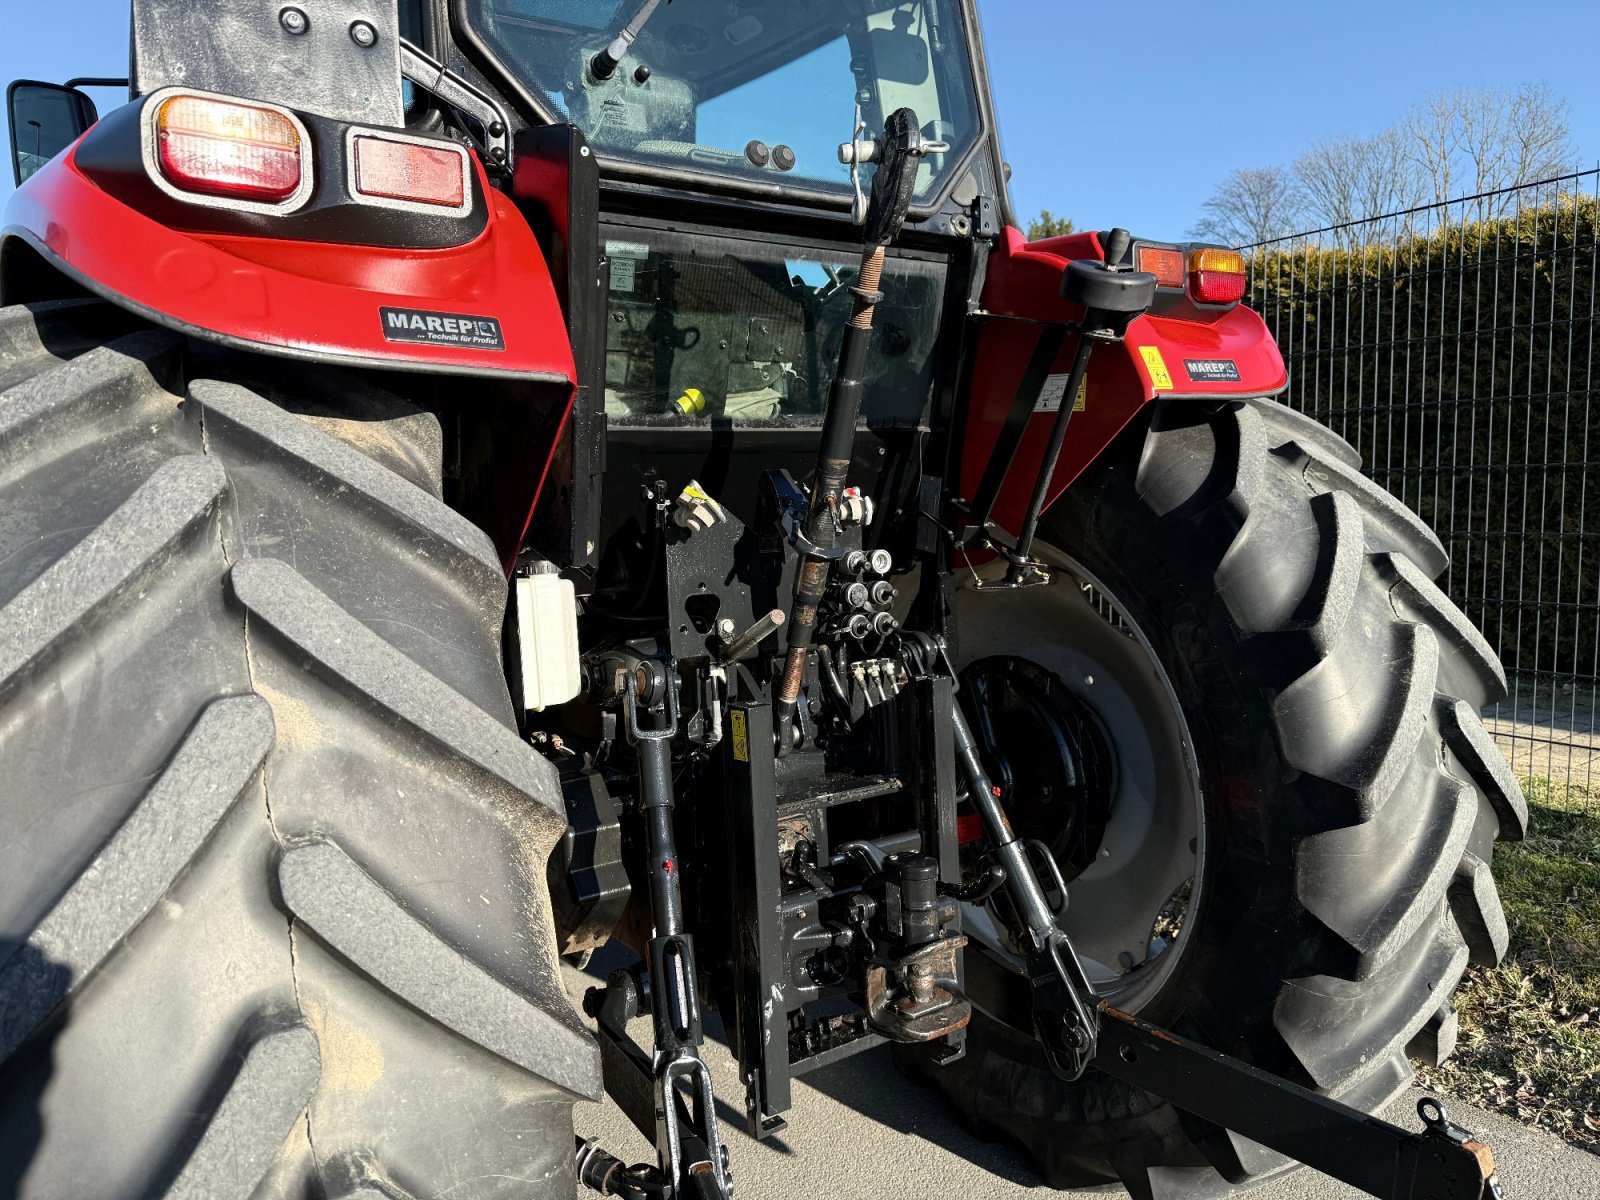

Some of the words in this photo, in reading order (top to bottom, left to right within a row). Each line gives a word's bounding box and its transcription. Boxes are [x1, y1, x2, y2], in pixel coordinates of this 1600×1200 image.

[387, 312, 473, 334] MAREP
[427, 332, 459, 342] Technik
[460, 334, 472, 343] für
[473, 336, 498, 345] Profis!
[1187, 362, 1225, 373] MAREP
